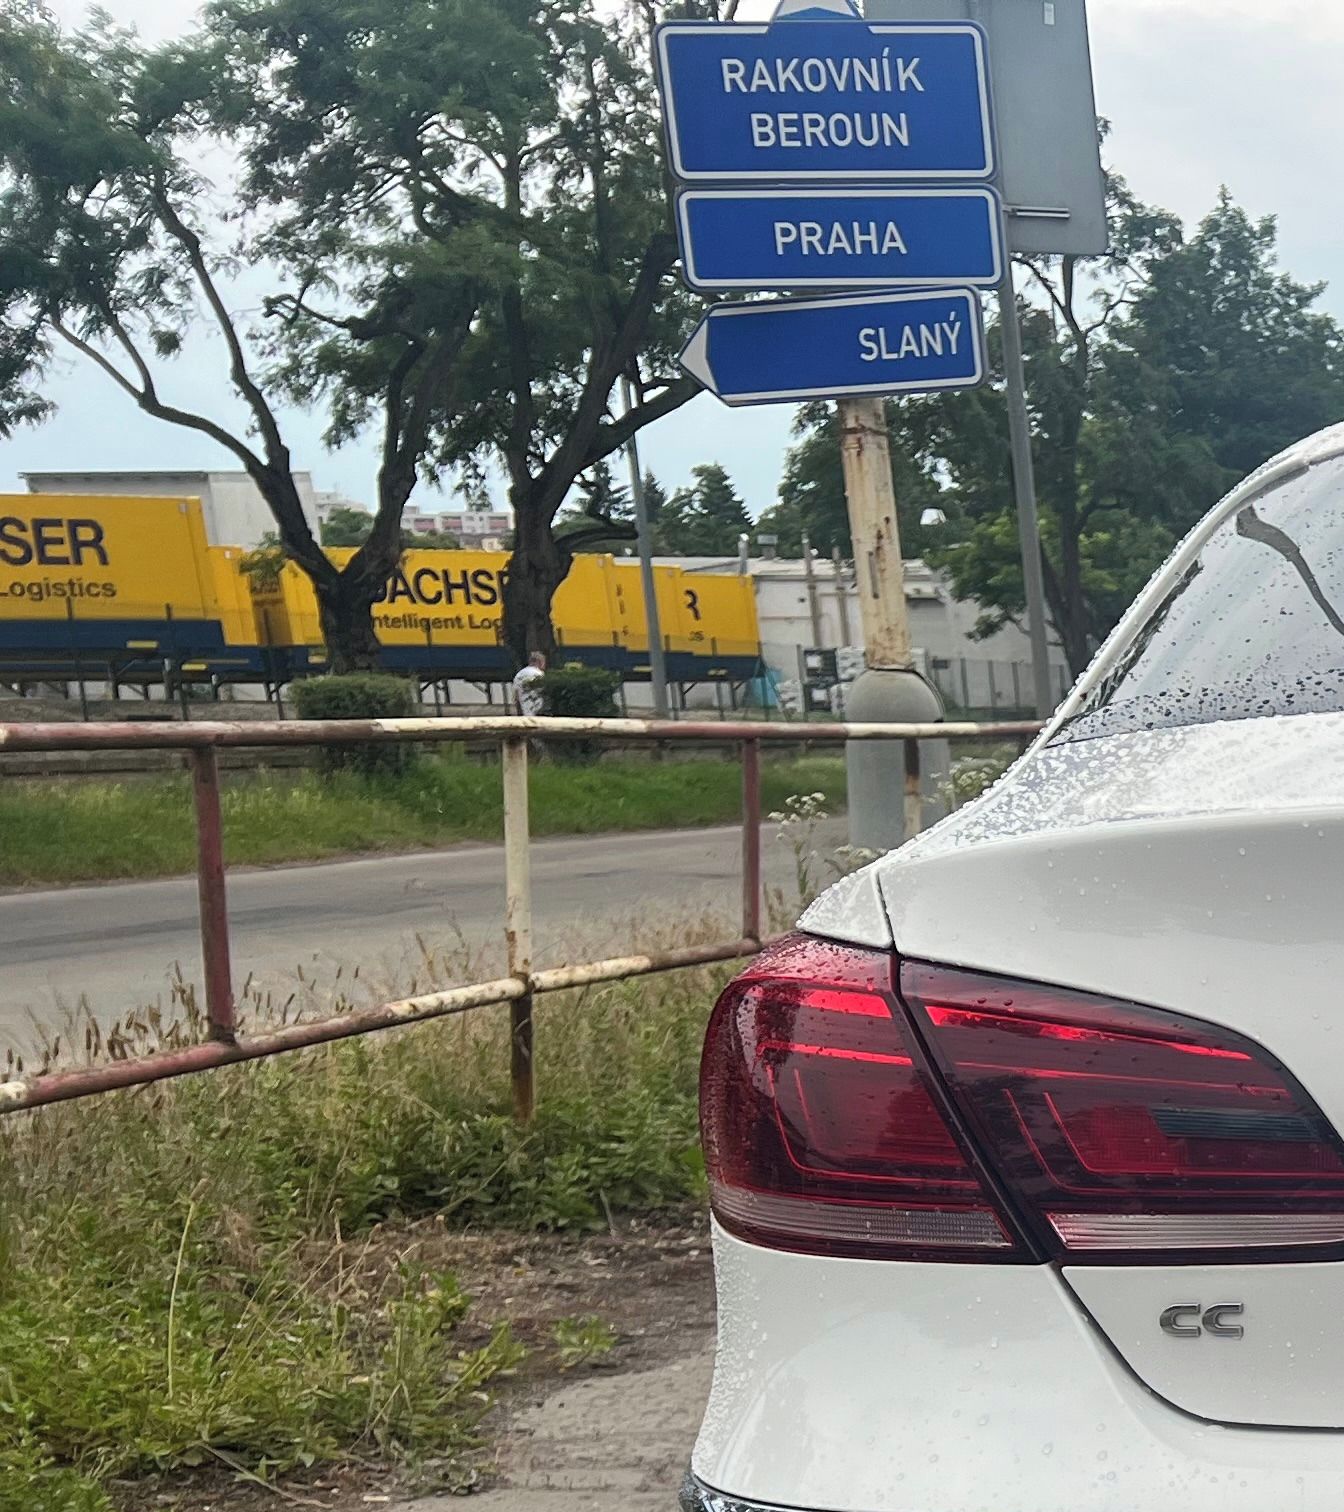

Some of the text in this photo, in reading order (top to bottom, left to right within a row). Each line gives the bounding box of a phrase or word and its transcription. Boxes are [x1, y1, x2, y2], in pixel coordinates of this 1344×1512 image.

[721, 47, 924, 93] RAKOVNÍK
[750, 113, 909, 147] BEROUN
[774, 221, 907, 255] PRAHA
[857, 311, 961, 361] SLANÝ
[372, 613, 464, 634] ntelligent
[1159, 1303, 1244, 1339] CC
